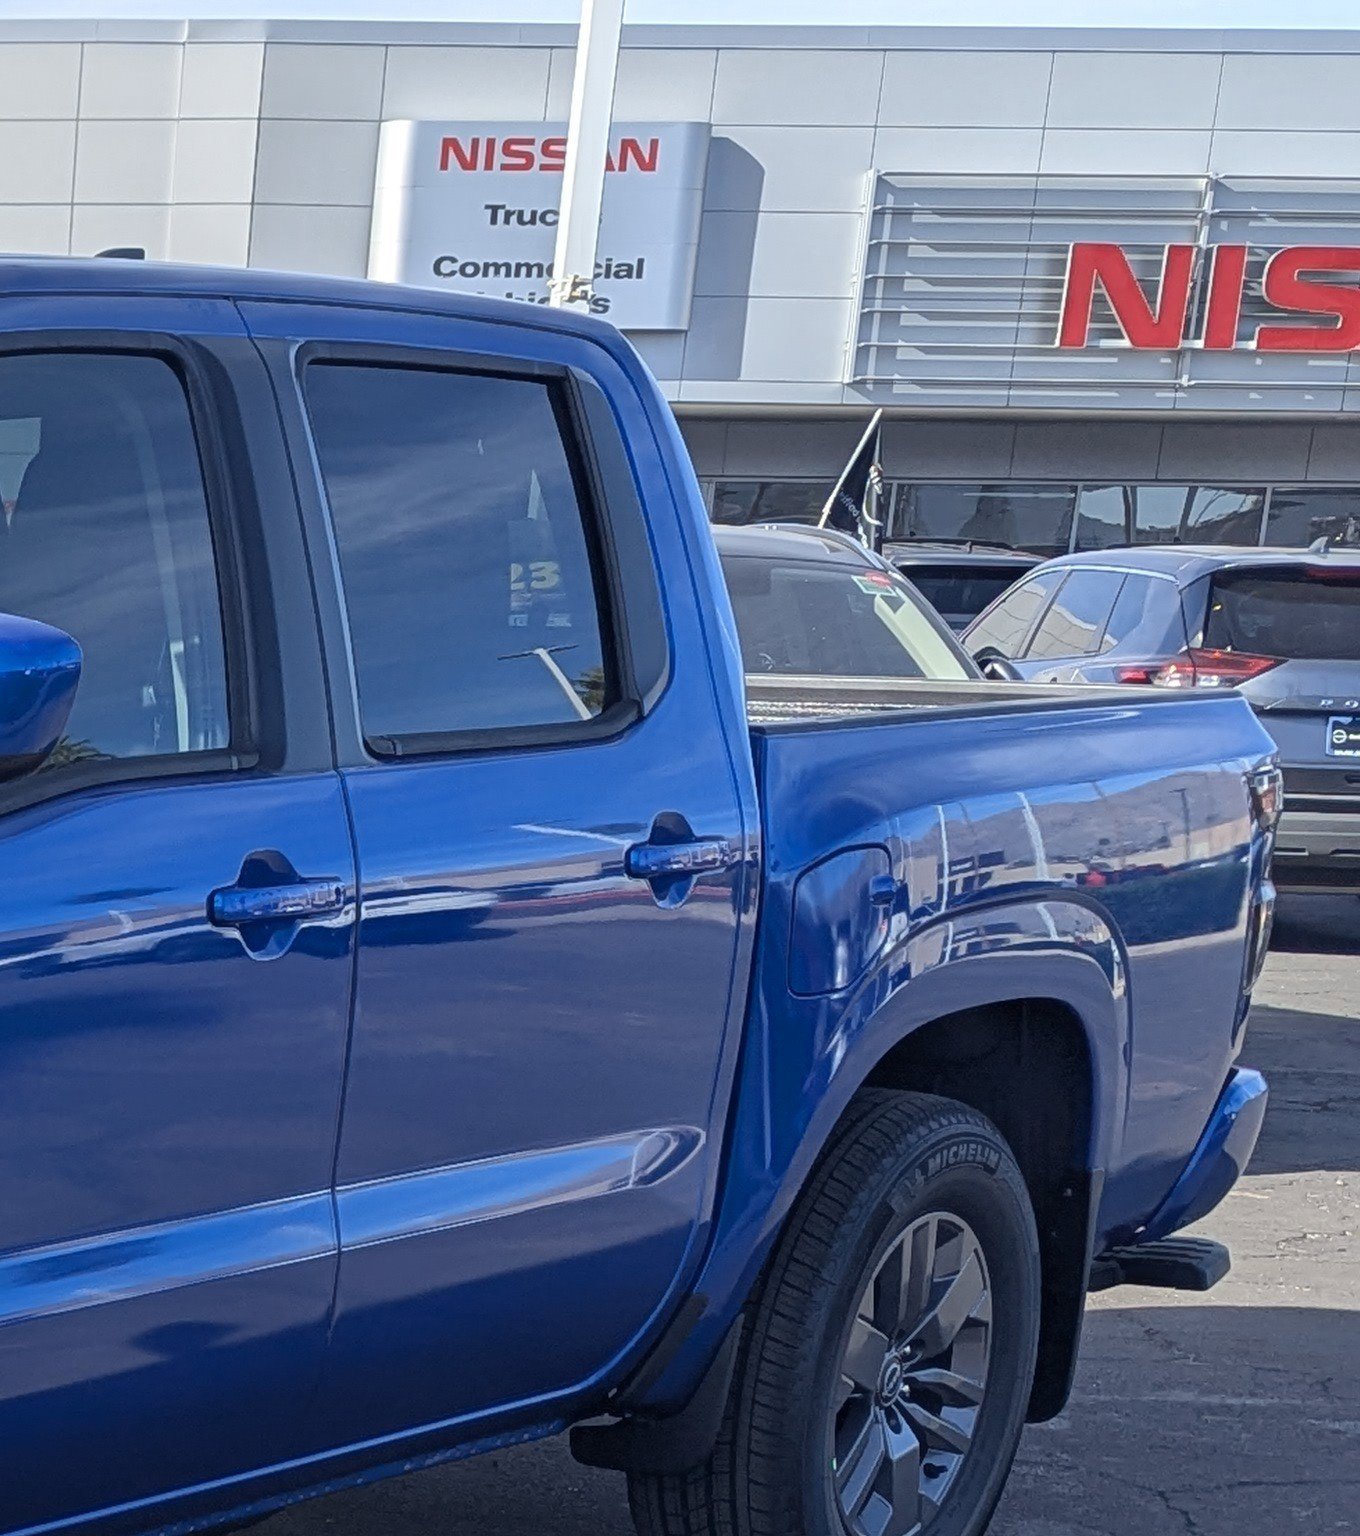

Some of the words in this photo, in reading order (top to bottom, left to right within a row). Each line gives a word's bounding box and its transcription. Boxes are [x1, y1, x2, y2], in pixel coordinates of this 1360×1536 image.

[439, 137, 659, 172] NISSN
[485, 203, 603, 227] Truc
[433, 255, 644, 280] Commial
[1056, 241, 1360, 352] NIS
[928, 1143, 1000, 1177] MICHELIN
